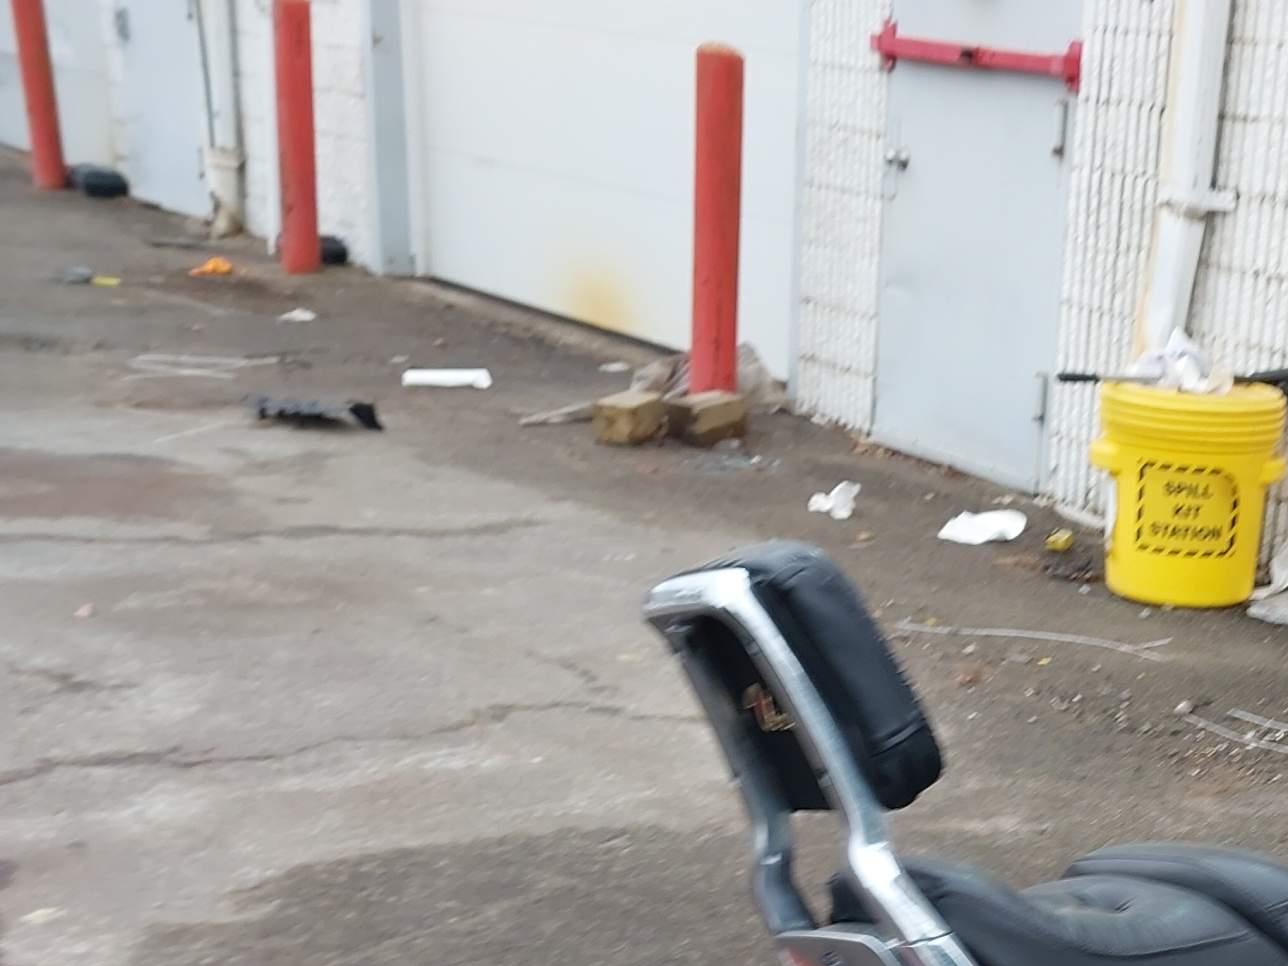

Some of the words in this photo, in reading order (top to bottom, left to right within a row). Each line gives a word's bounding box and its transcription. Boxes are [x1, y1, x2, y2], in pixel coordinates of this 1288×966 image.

[1164, 481, 1212, 499] SPILL
[1174, 504, 1202, 518] KIT
[1151, 522, 1222, 541] STATION
